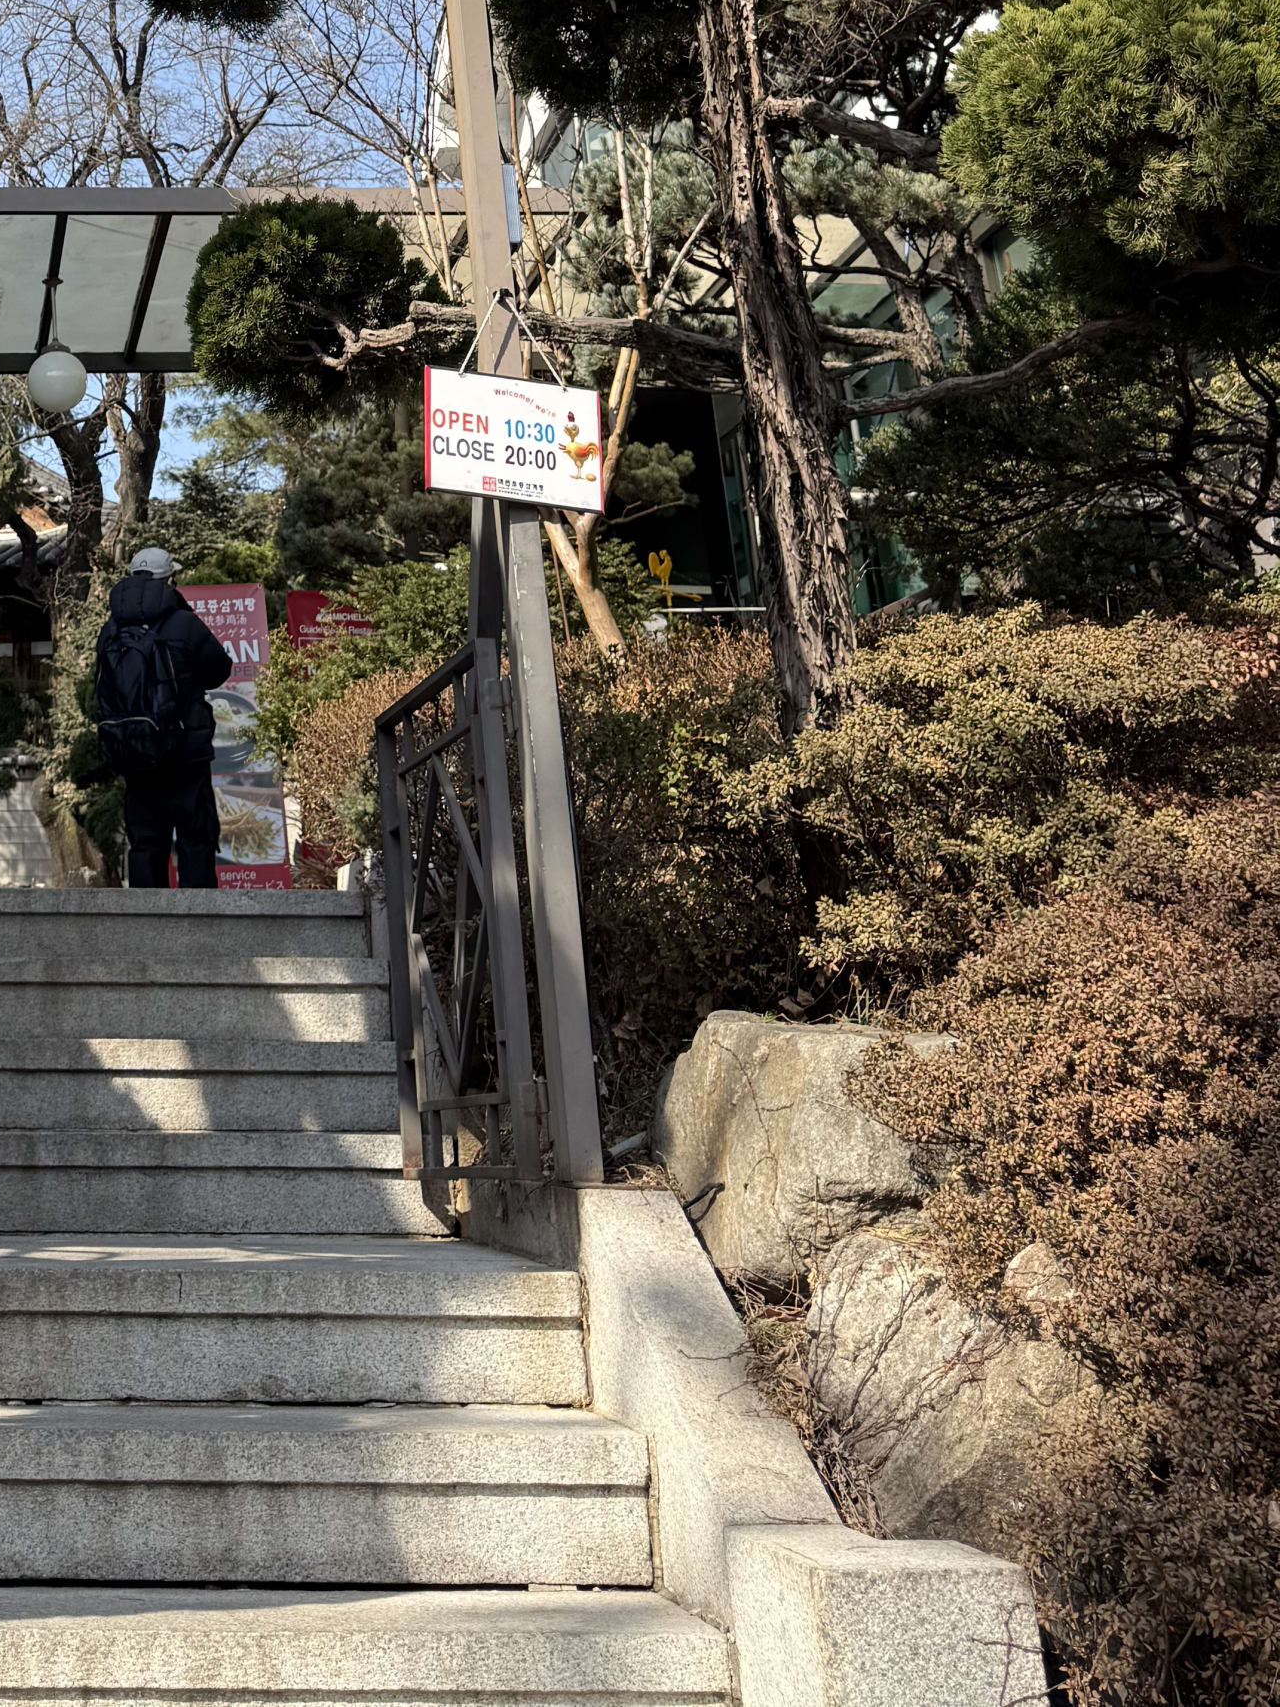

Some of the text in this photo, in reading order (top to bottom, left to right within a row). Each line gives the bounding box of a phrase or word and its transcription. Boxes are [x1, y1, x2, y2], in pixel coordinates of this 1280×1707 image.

[432, 408, 555, 444] OPEN 10:30
[433, 435, 557, 471] CLOSE 20:00
[332, 612, 373, 622] MICHELN
[211, 627, 259, 638] ンゲタン
[220, 869, 256, 881] service
